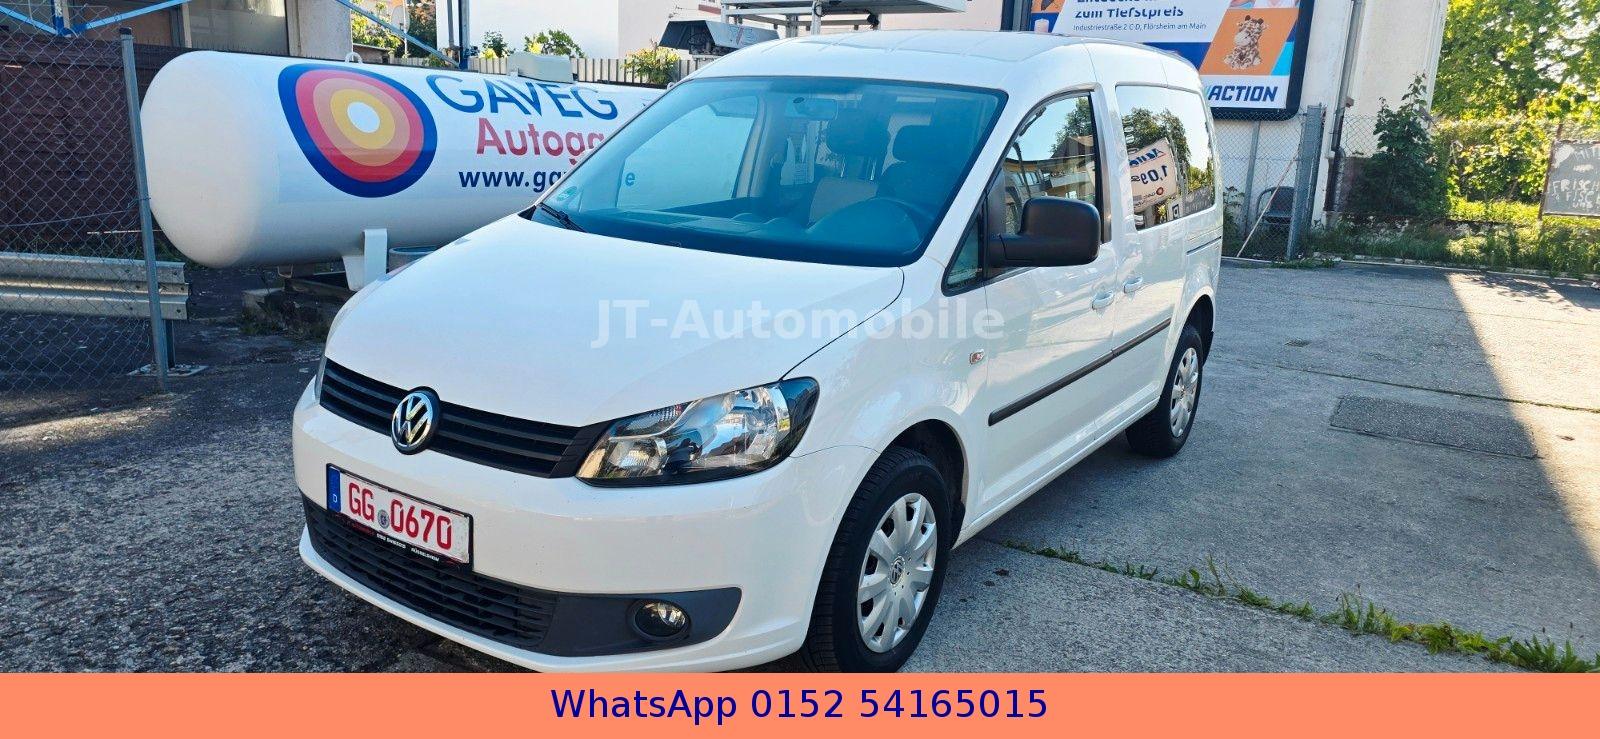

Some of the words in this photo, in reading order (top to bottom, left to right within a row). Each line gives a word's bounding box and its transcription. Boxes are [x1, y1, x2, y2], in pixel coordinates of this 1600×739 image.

[1107, 6, 1184, 19] Tiefstpreis
[425, 74, 618, 120] GAVEG
[1208, 85, 1278, 102] ACTION
[476, 117, 605, 165] Autog
[348, 482, 375, 523] GG
[390, 499, 452, 550] 0670
